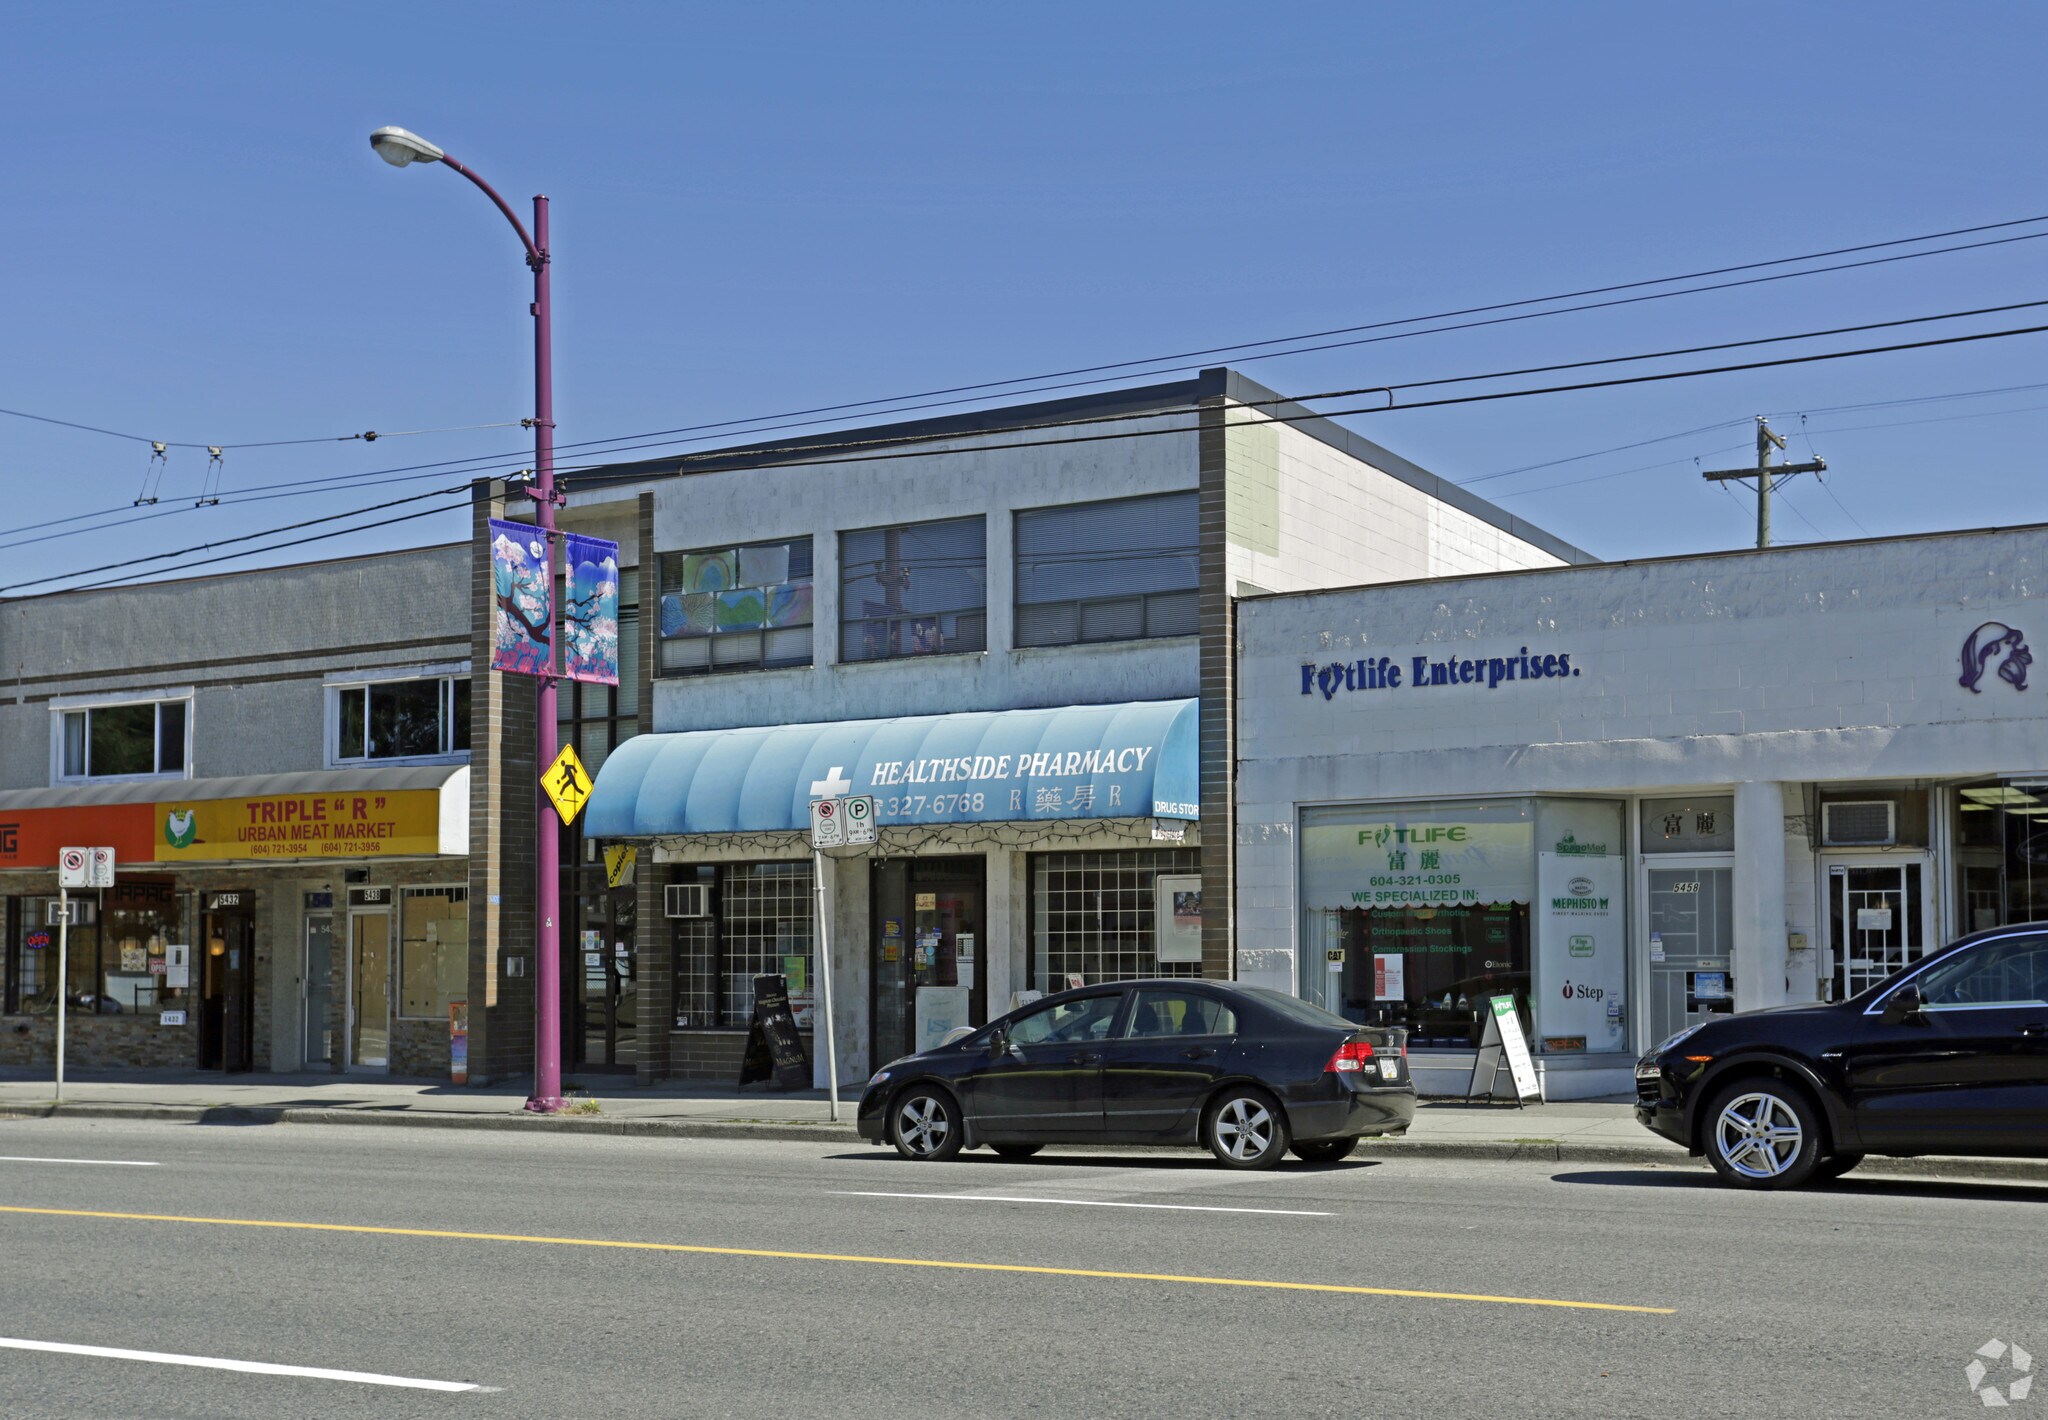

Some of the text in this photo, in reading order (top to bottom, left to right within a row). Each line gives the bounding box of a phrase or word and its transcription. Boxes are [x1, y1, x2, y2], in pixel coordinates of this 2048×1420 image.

[1412, 646, 1580, 688] Enterprises.
[870, 746, 1152, 785] HEALTHSIDE PHARMACY
[887, 793, 985, 816] 327-6768
[1155, 801, 1178, 813] DRUG
[247, 799, 326, 824] TRIPLE
[238, 822, 396, 842] URBAN MEAT MARKET
[250, 842, 380, 856] (604) 721-3954 (604) 721-3956
[1370, 874, 1460, 886] 604-321-0305
[1673, 883, 1699, 893] 5458
[219, 894, 239, 905] 5432
[1352, 889, 1479, 902] WE SPECIALIZED IN:
[1553, 898, 1597, 909] MEPHISTO
[1432, 908, 1470, 917] rthotics
[1372, 927, 1452, 937] Orthopaedic Shoes
[1328, 951, 1343, 960] CAT
[1372, 944, 1472, 955] Compression Stockings
[1577, 984, 1603, 1002] Step
